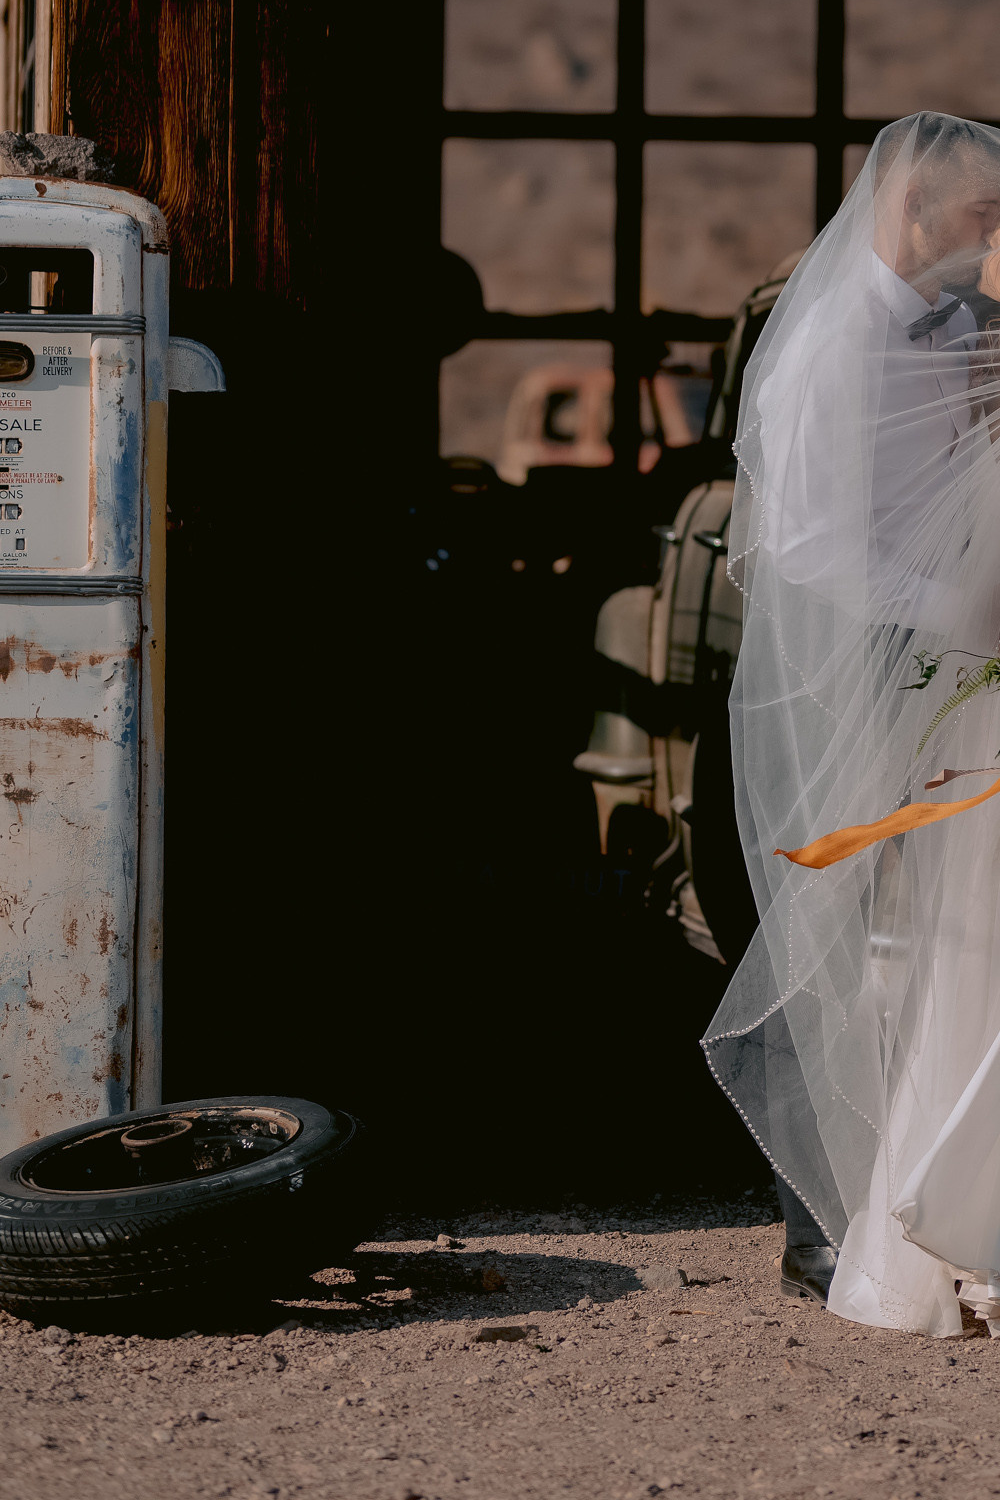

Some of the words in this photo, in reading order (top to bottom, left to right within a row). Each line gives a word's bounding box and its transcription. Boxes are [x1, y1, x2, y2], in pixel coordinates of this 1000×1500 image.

[42, 346, 66, 355] BEFORE
[67, 346, 72, 355] &
[48, 356, 69, 366] AFTER
[42, 366, 73, 376] DELIVERY
[0, 418, 42, 431] SALE
